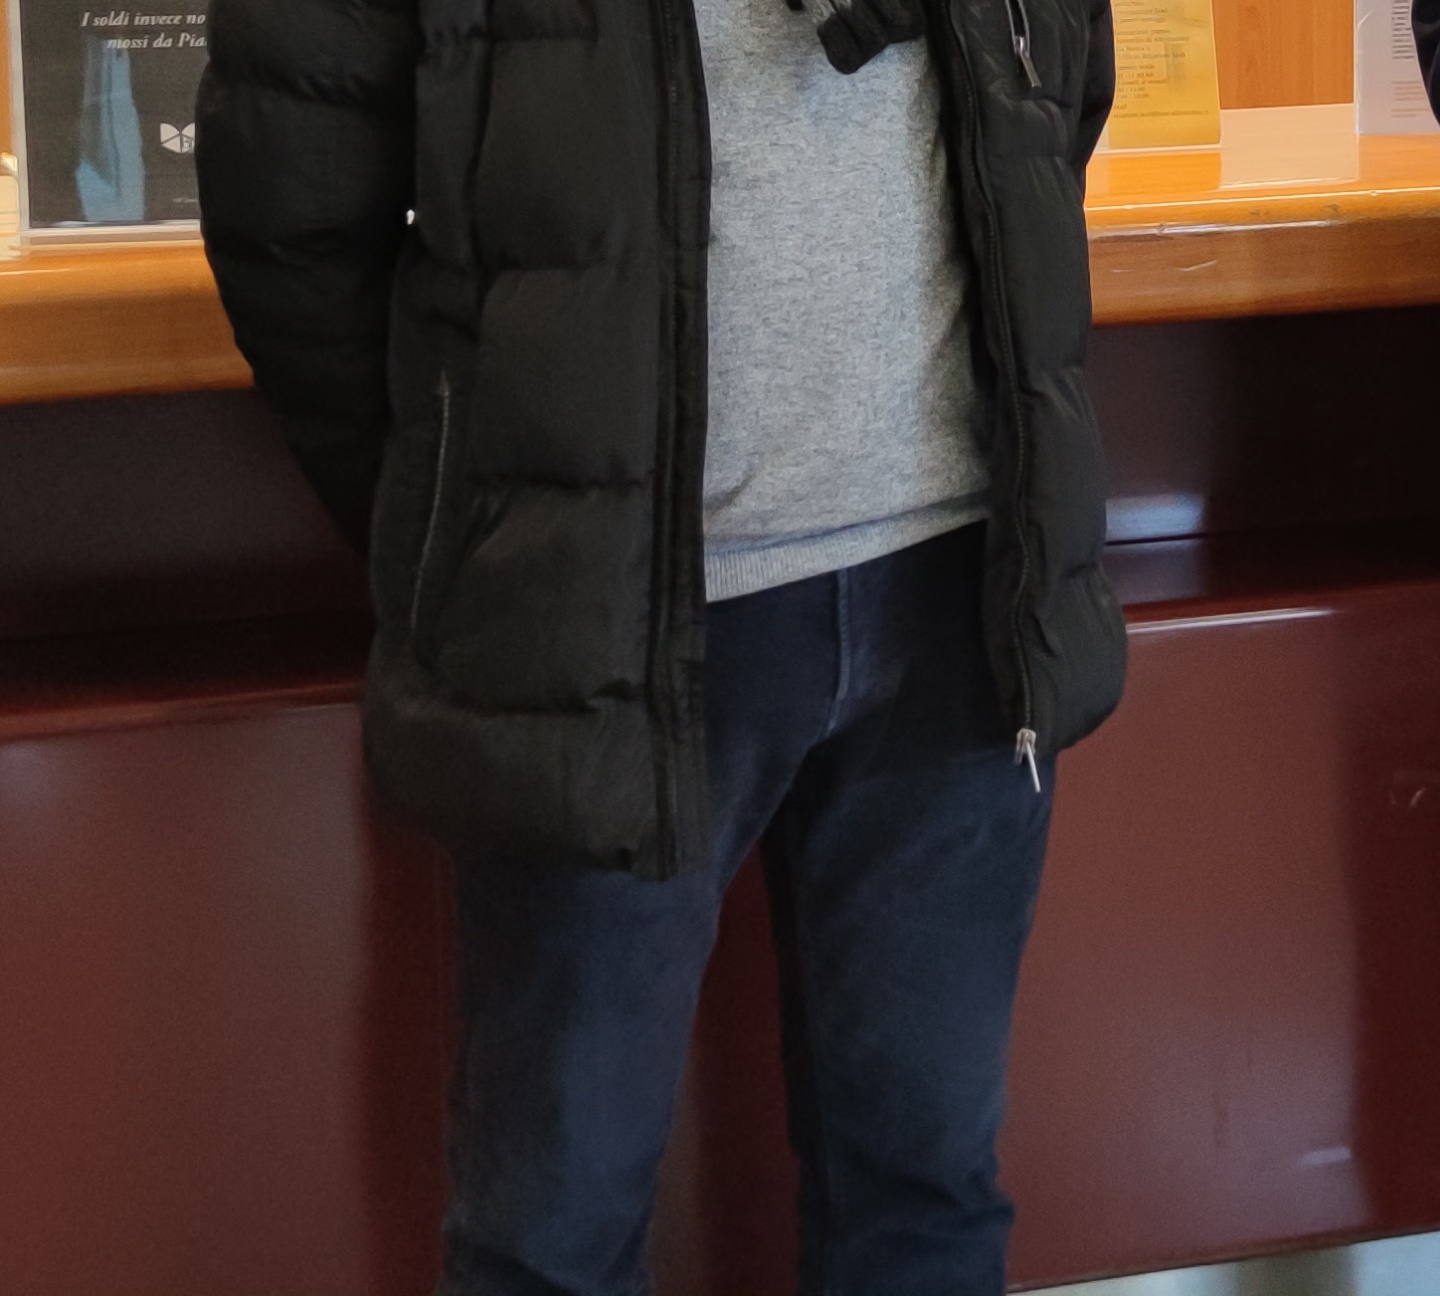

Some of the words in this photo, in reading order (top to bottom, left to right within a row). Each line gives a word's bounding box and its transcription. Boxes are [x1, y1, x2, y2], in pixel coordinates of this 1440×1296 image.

[80, 11, 91, 27] I
[92, 10, 131, 27] soldi
[133, 12, 182, 26] invece
[185, 14, 206, 25] no
[107, 34, 151, 49] mossi
[152, 32, 173, 48] da
[177, 32, 207, 48] Pia
